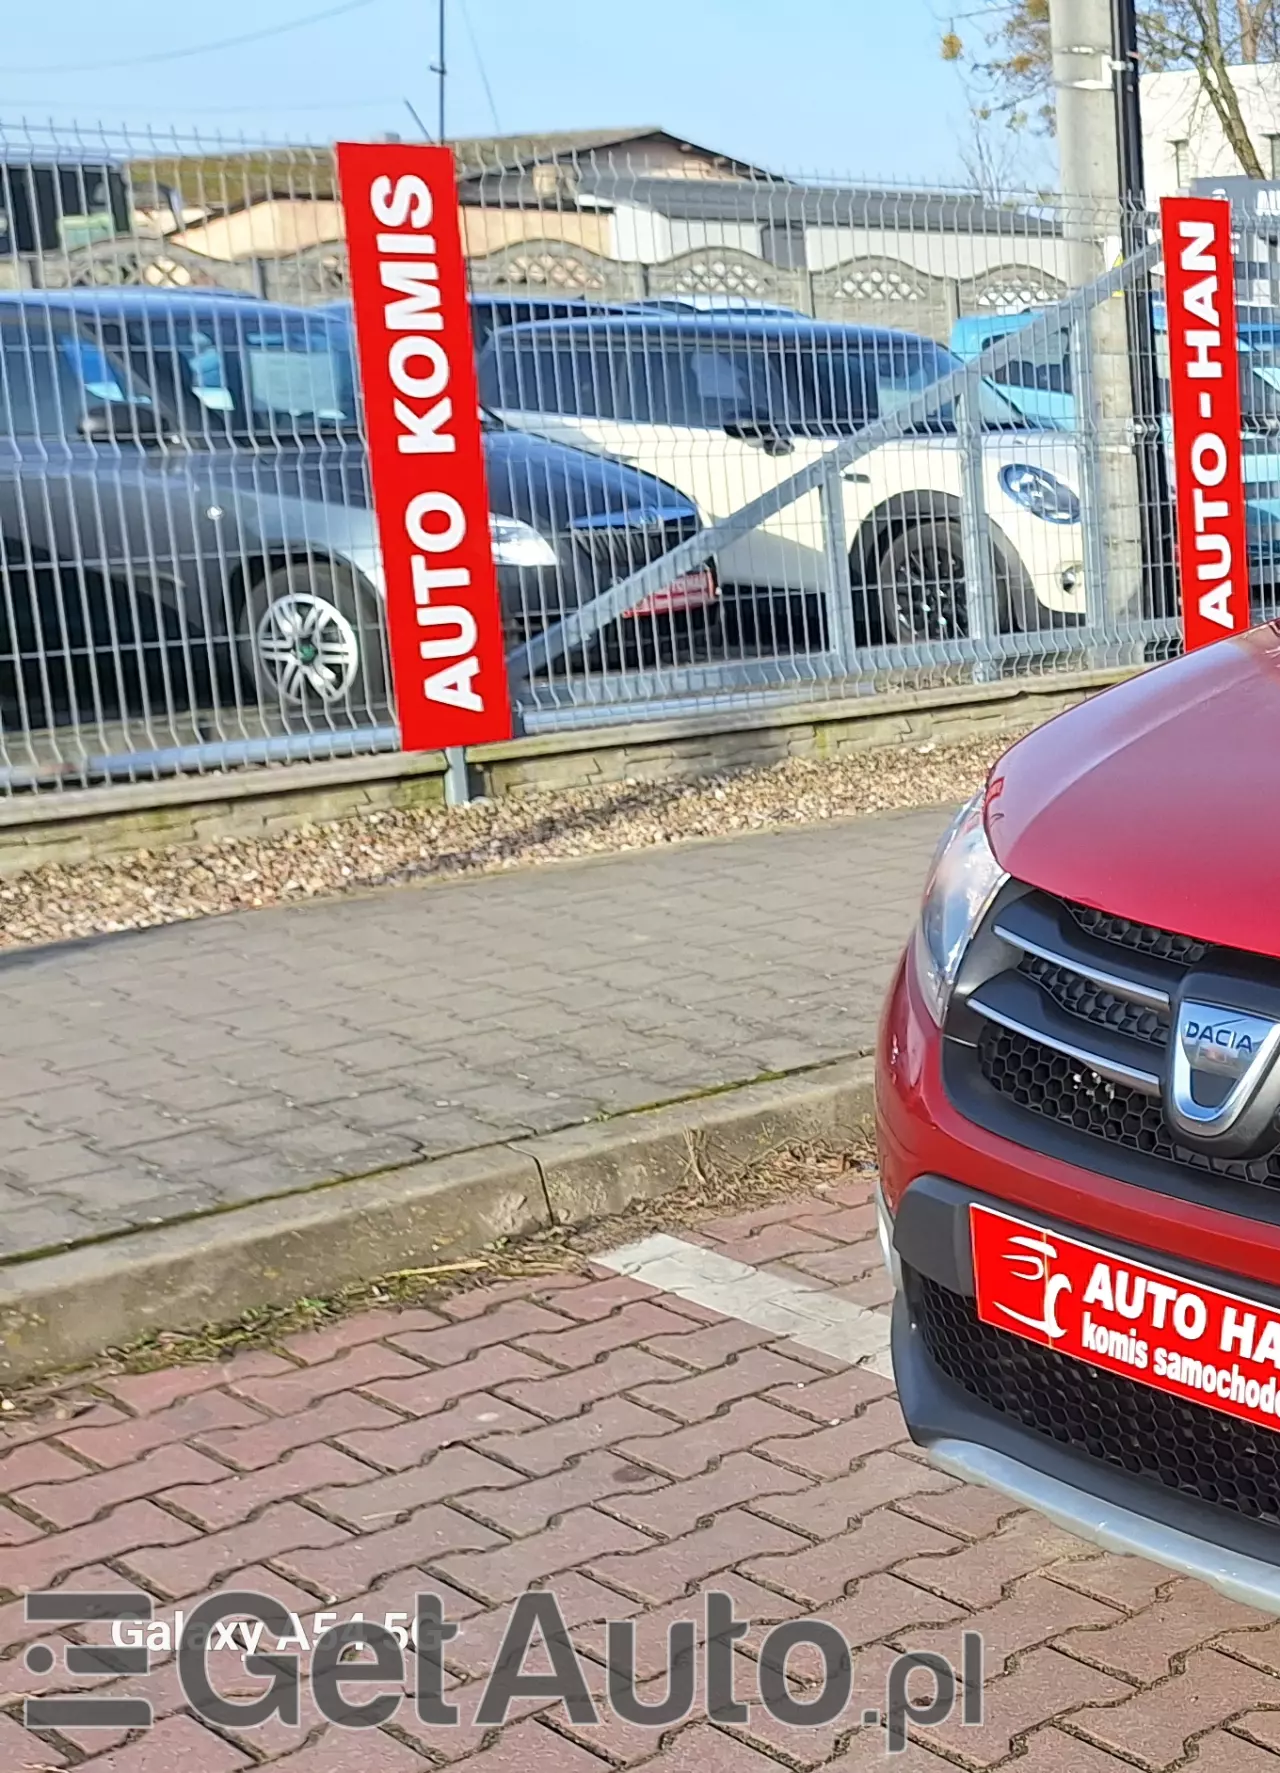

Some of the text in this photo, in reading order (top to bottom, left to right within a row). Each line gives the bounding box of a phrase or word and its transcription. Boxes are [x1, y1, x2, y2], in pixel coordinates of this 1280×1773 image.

[370, 174, 485, 712] AUTO KOMIS
[1185, 1021, 1253, 1053] DACIA
[1083, 1262, 1207, 1340] AUTO
[1081, 1311, 1149, 1369] komis
